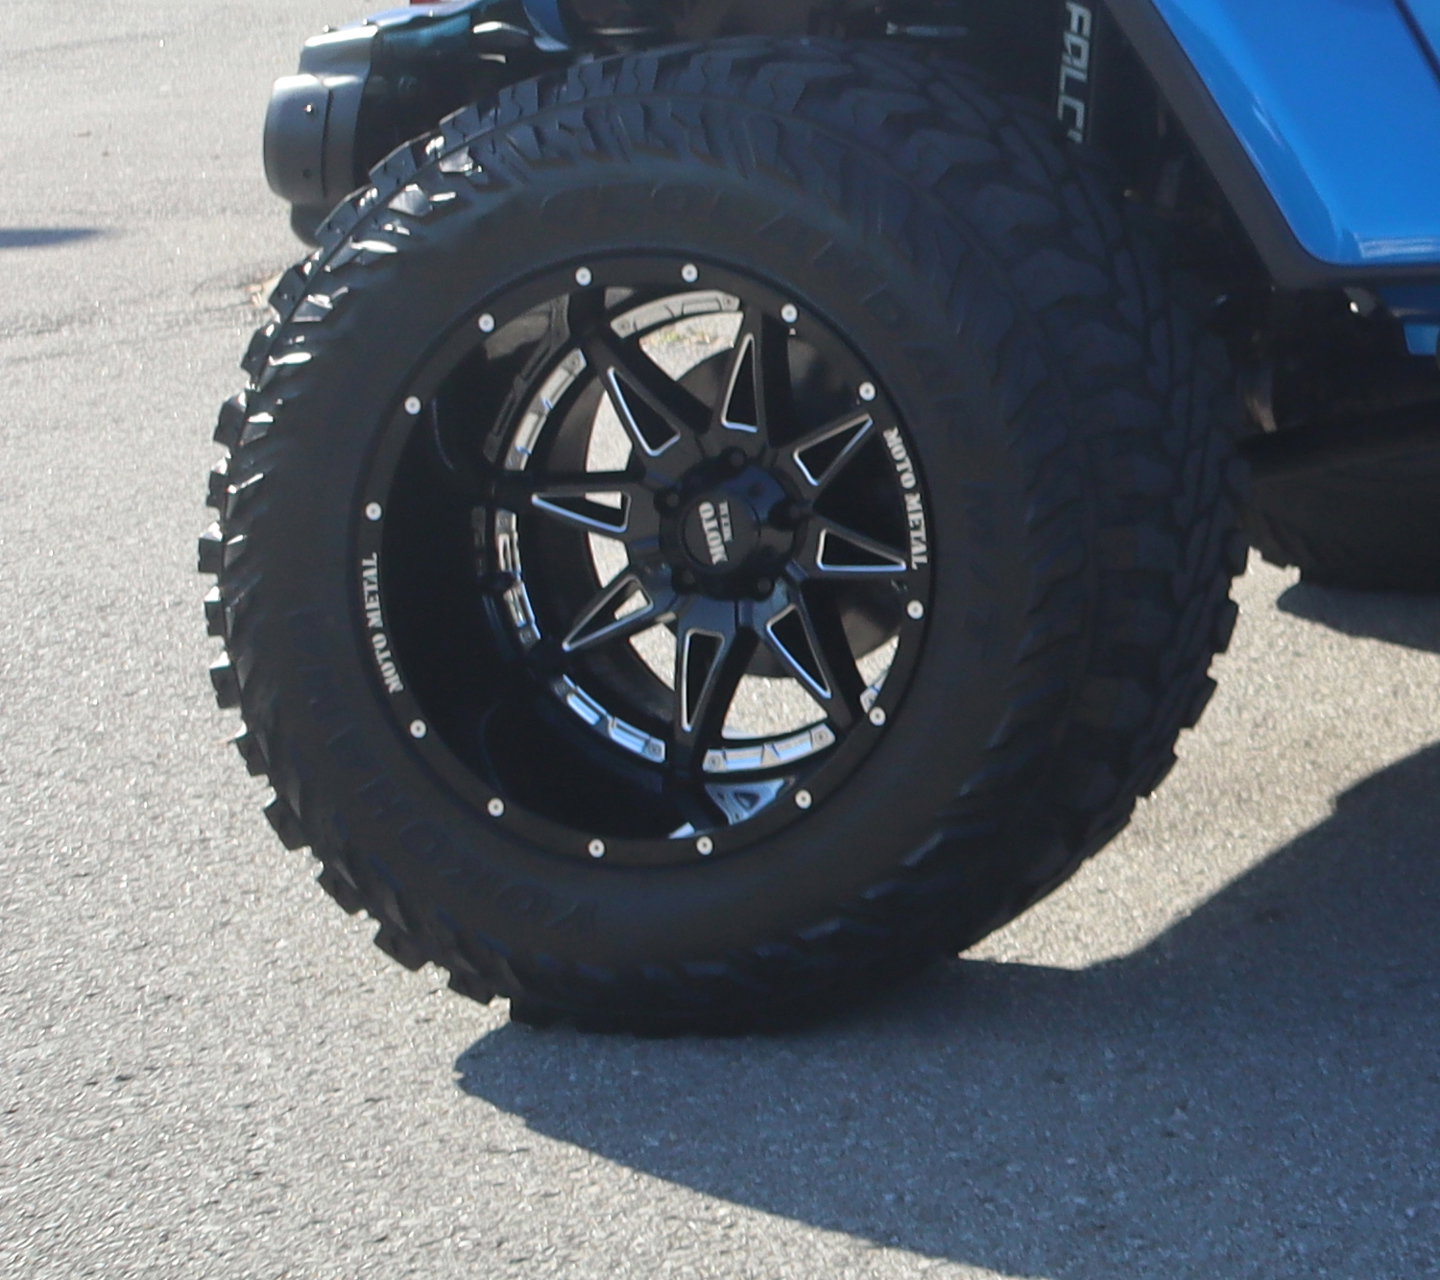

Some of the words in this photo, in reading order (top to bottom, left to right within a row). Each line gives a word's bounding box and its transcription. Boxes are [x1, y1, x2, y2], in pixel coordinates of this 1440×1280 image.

[1058, 1, 1091, 143] FALC
[883, 426, 916, 489] MOTO
[904, 492, 928, 570] METAL
[361, 551, 383, 628] METAL
[372, 633, 404, 695] MOTO
